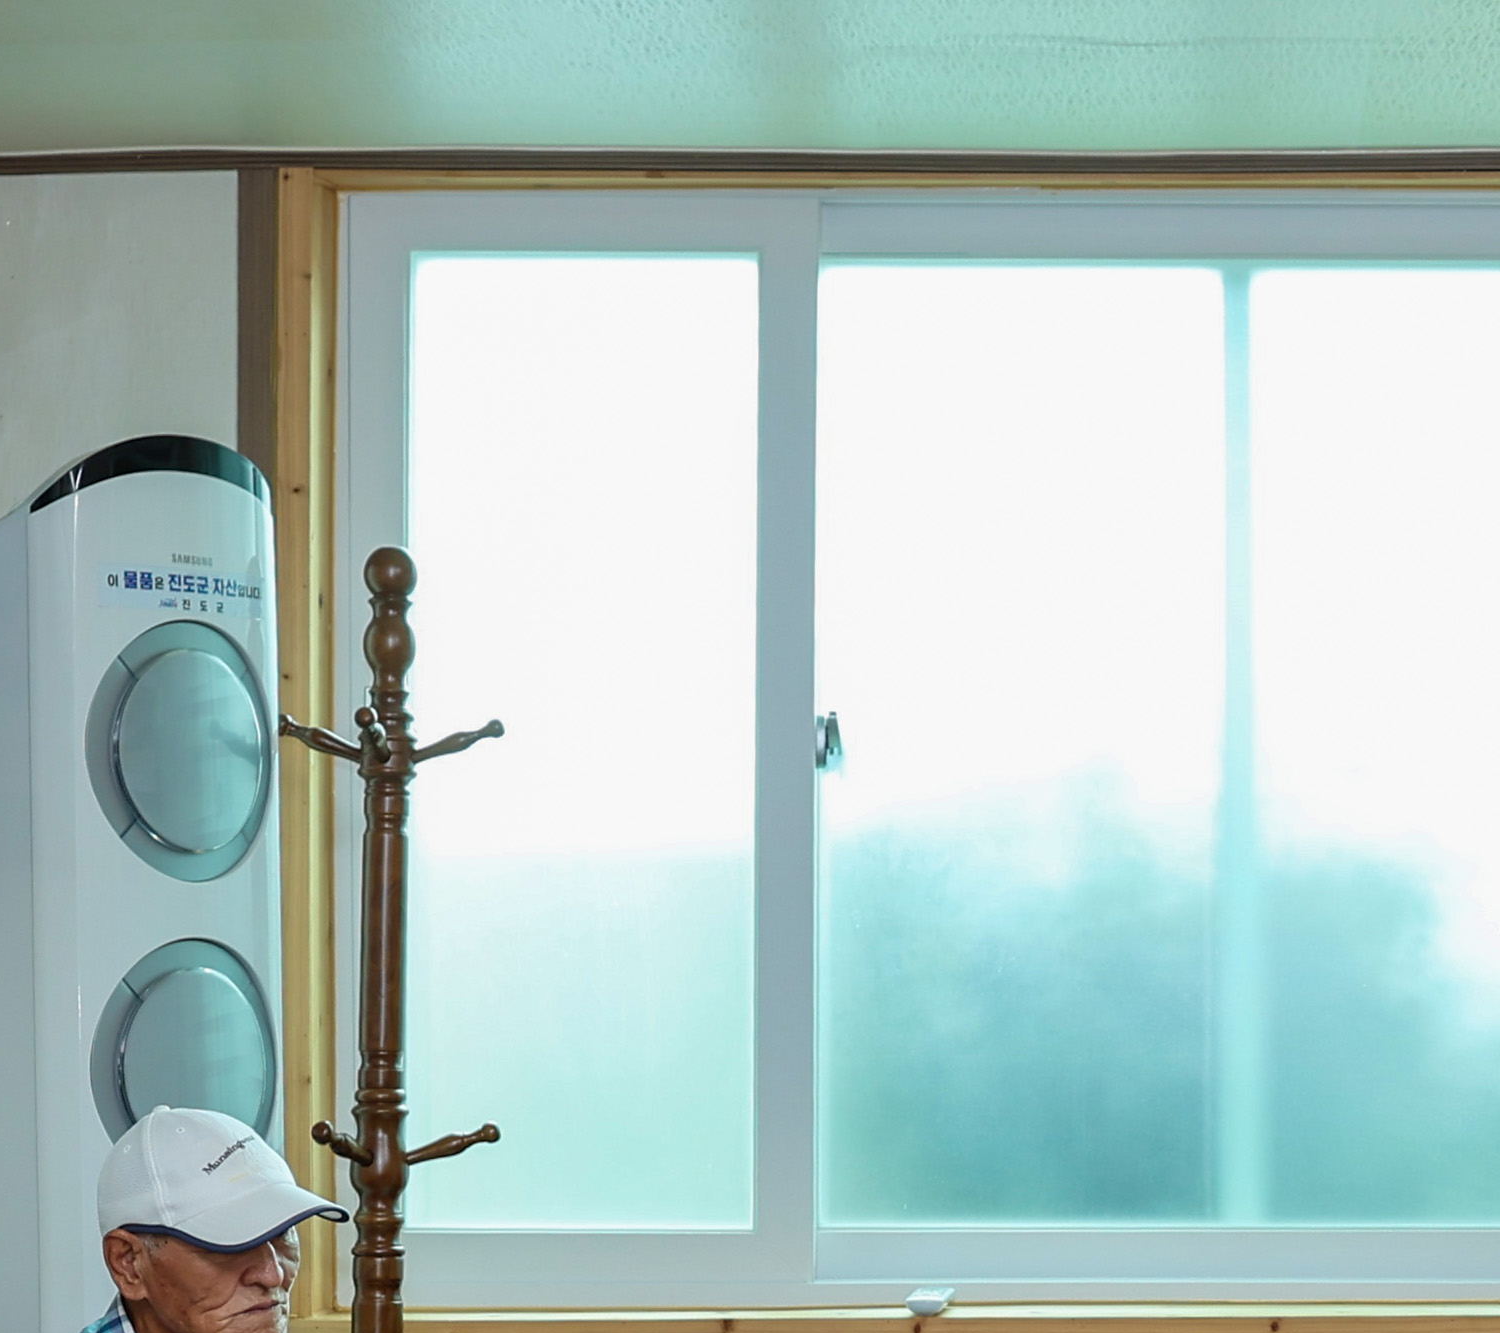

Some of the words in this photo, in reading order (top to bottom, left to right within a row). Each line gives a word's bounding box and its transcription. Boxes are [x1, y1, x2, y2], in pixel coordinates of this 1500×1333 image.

[171, 553, 214, 567] SAMSUNG
[107, 573, 119, 588] 이
[123, 570, 164, 590] 물품은
[168, 573, 209, 594] 진도군
